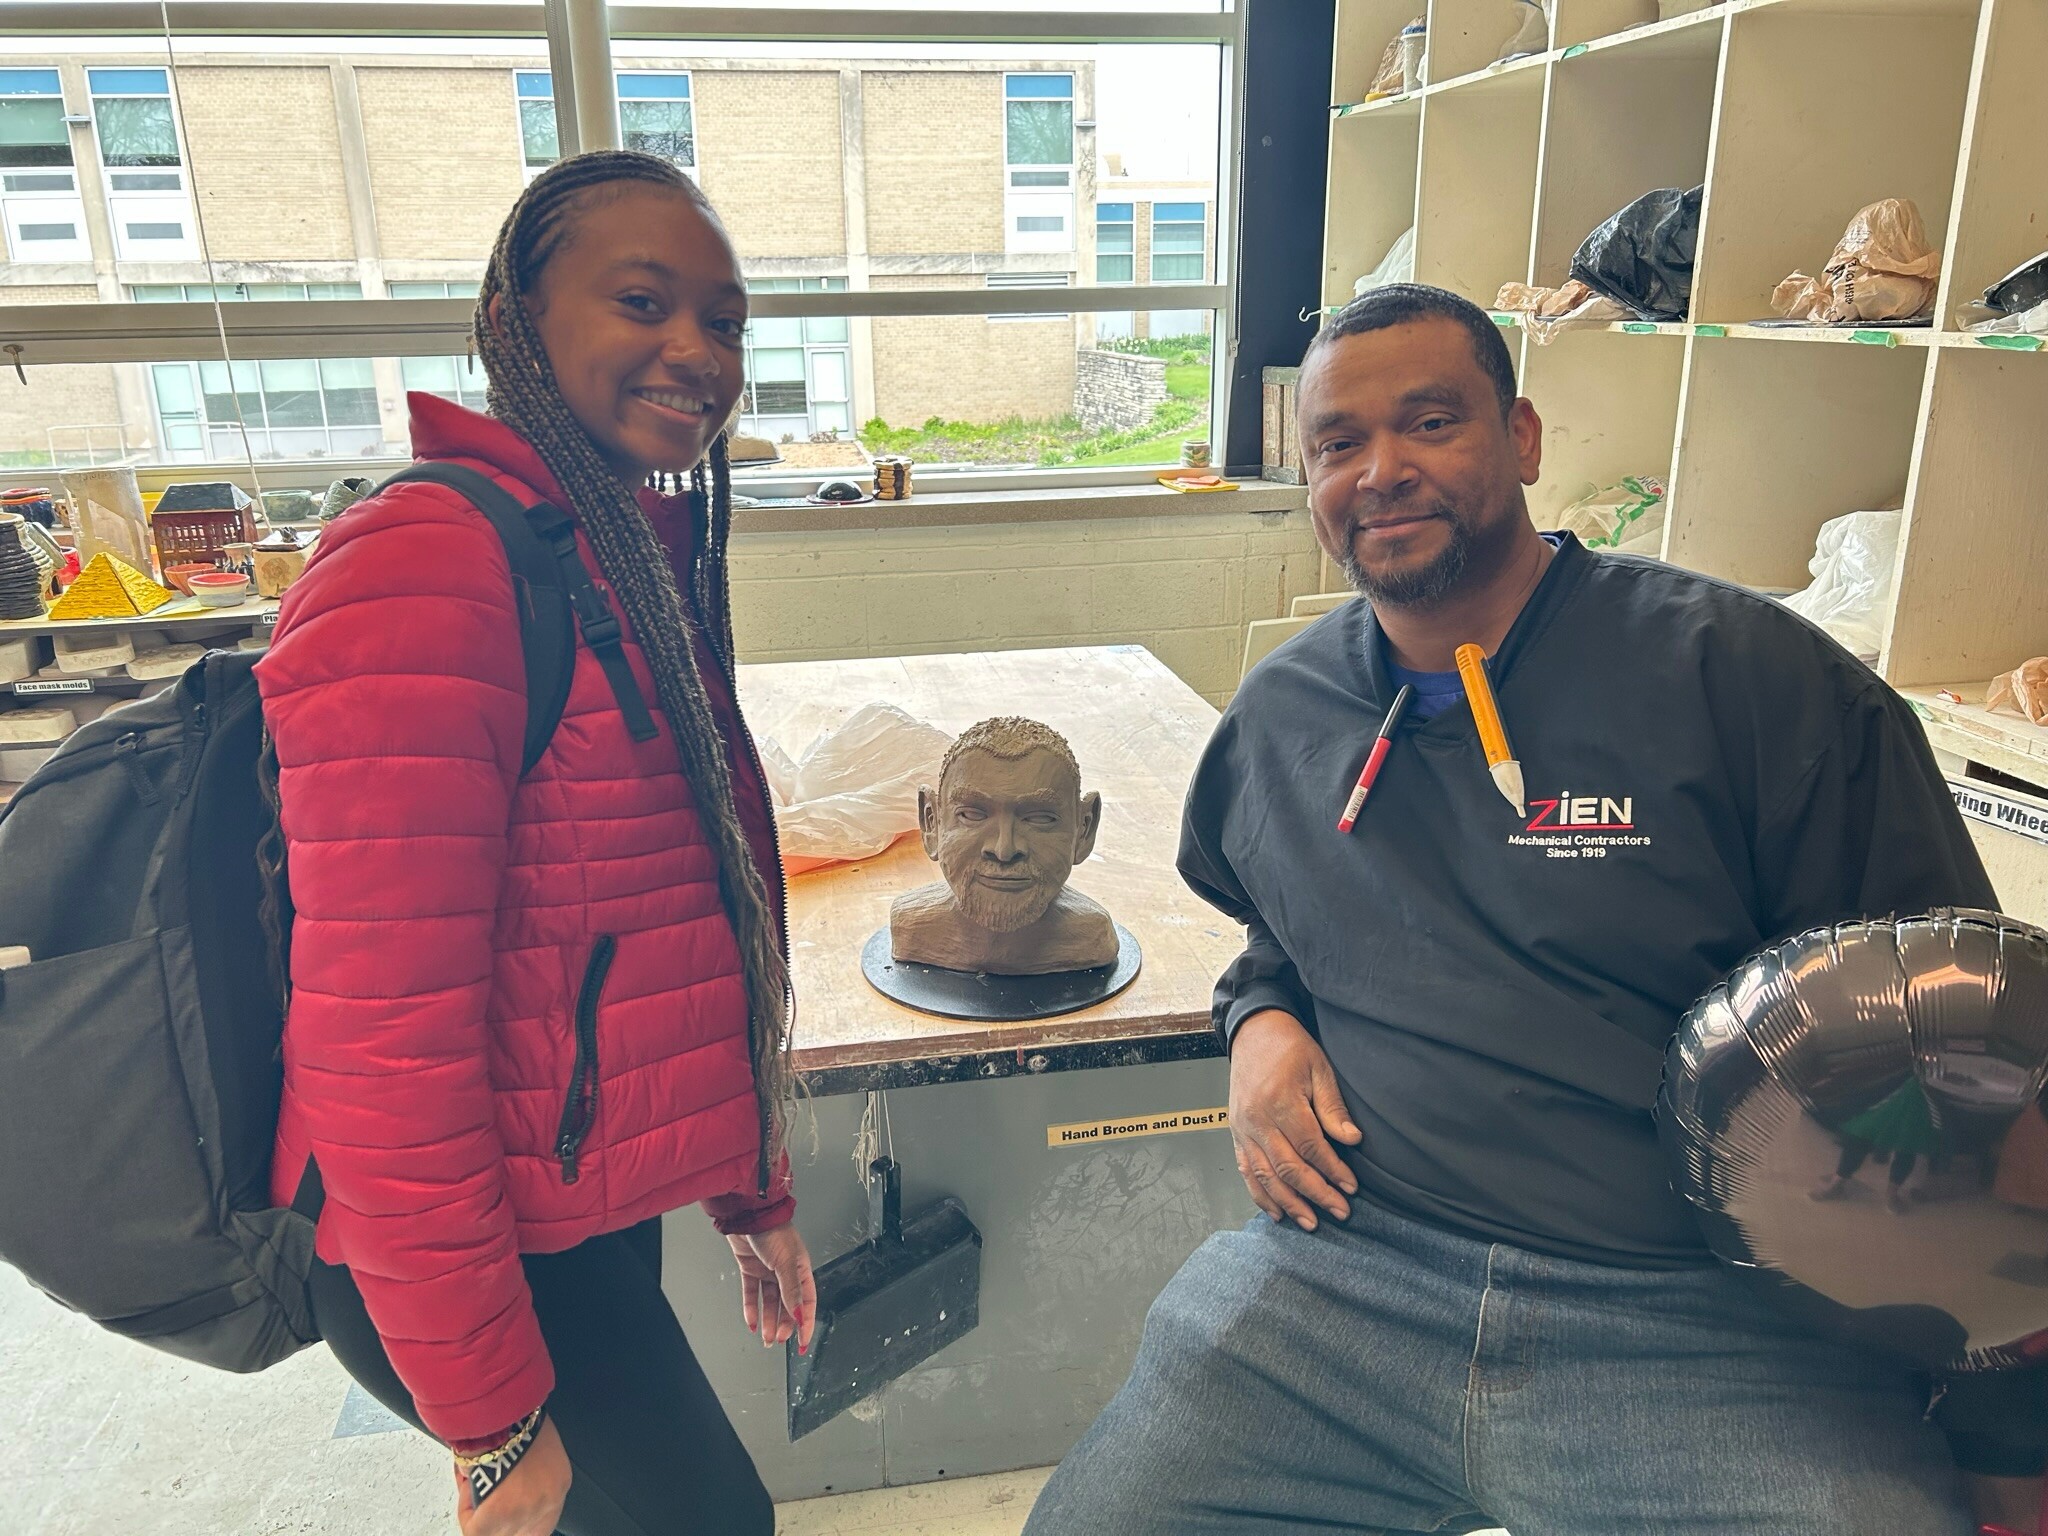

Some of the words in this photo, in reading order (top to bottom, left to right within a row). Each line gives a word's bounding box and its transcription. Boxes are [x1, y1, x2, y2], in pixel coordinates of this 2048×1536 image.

[18, 683, 38, 691] Face
[39, 683, 61, 691] mask
[62, 682, 88, 690] molds
[1508, 834, 1572, 847] Mechanical
[1574, 834, 1652, 847] Contractors
[1546, 847, 1579, 859] Since
[1581, 847, 1607, 859] 1919
[1062, 1127, 1098, 1141] Hand
[1102, 1123, 1148, 1136] Broom
[1152, 1117, 1178, 1130] and
[1182, 1113, 1214, 1126] Dust
[1218, 1112, 1229, 1122] P
